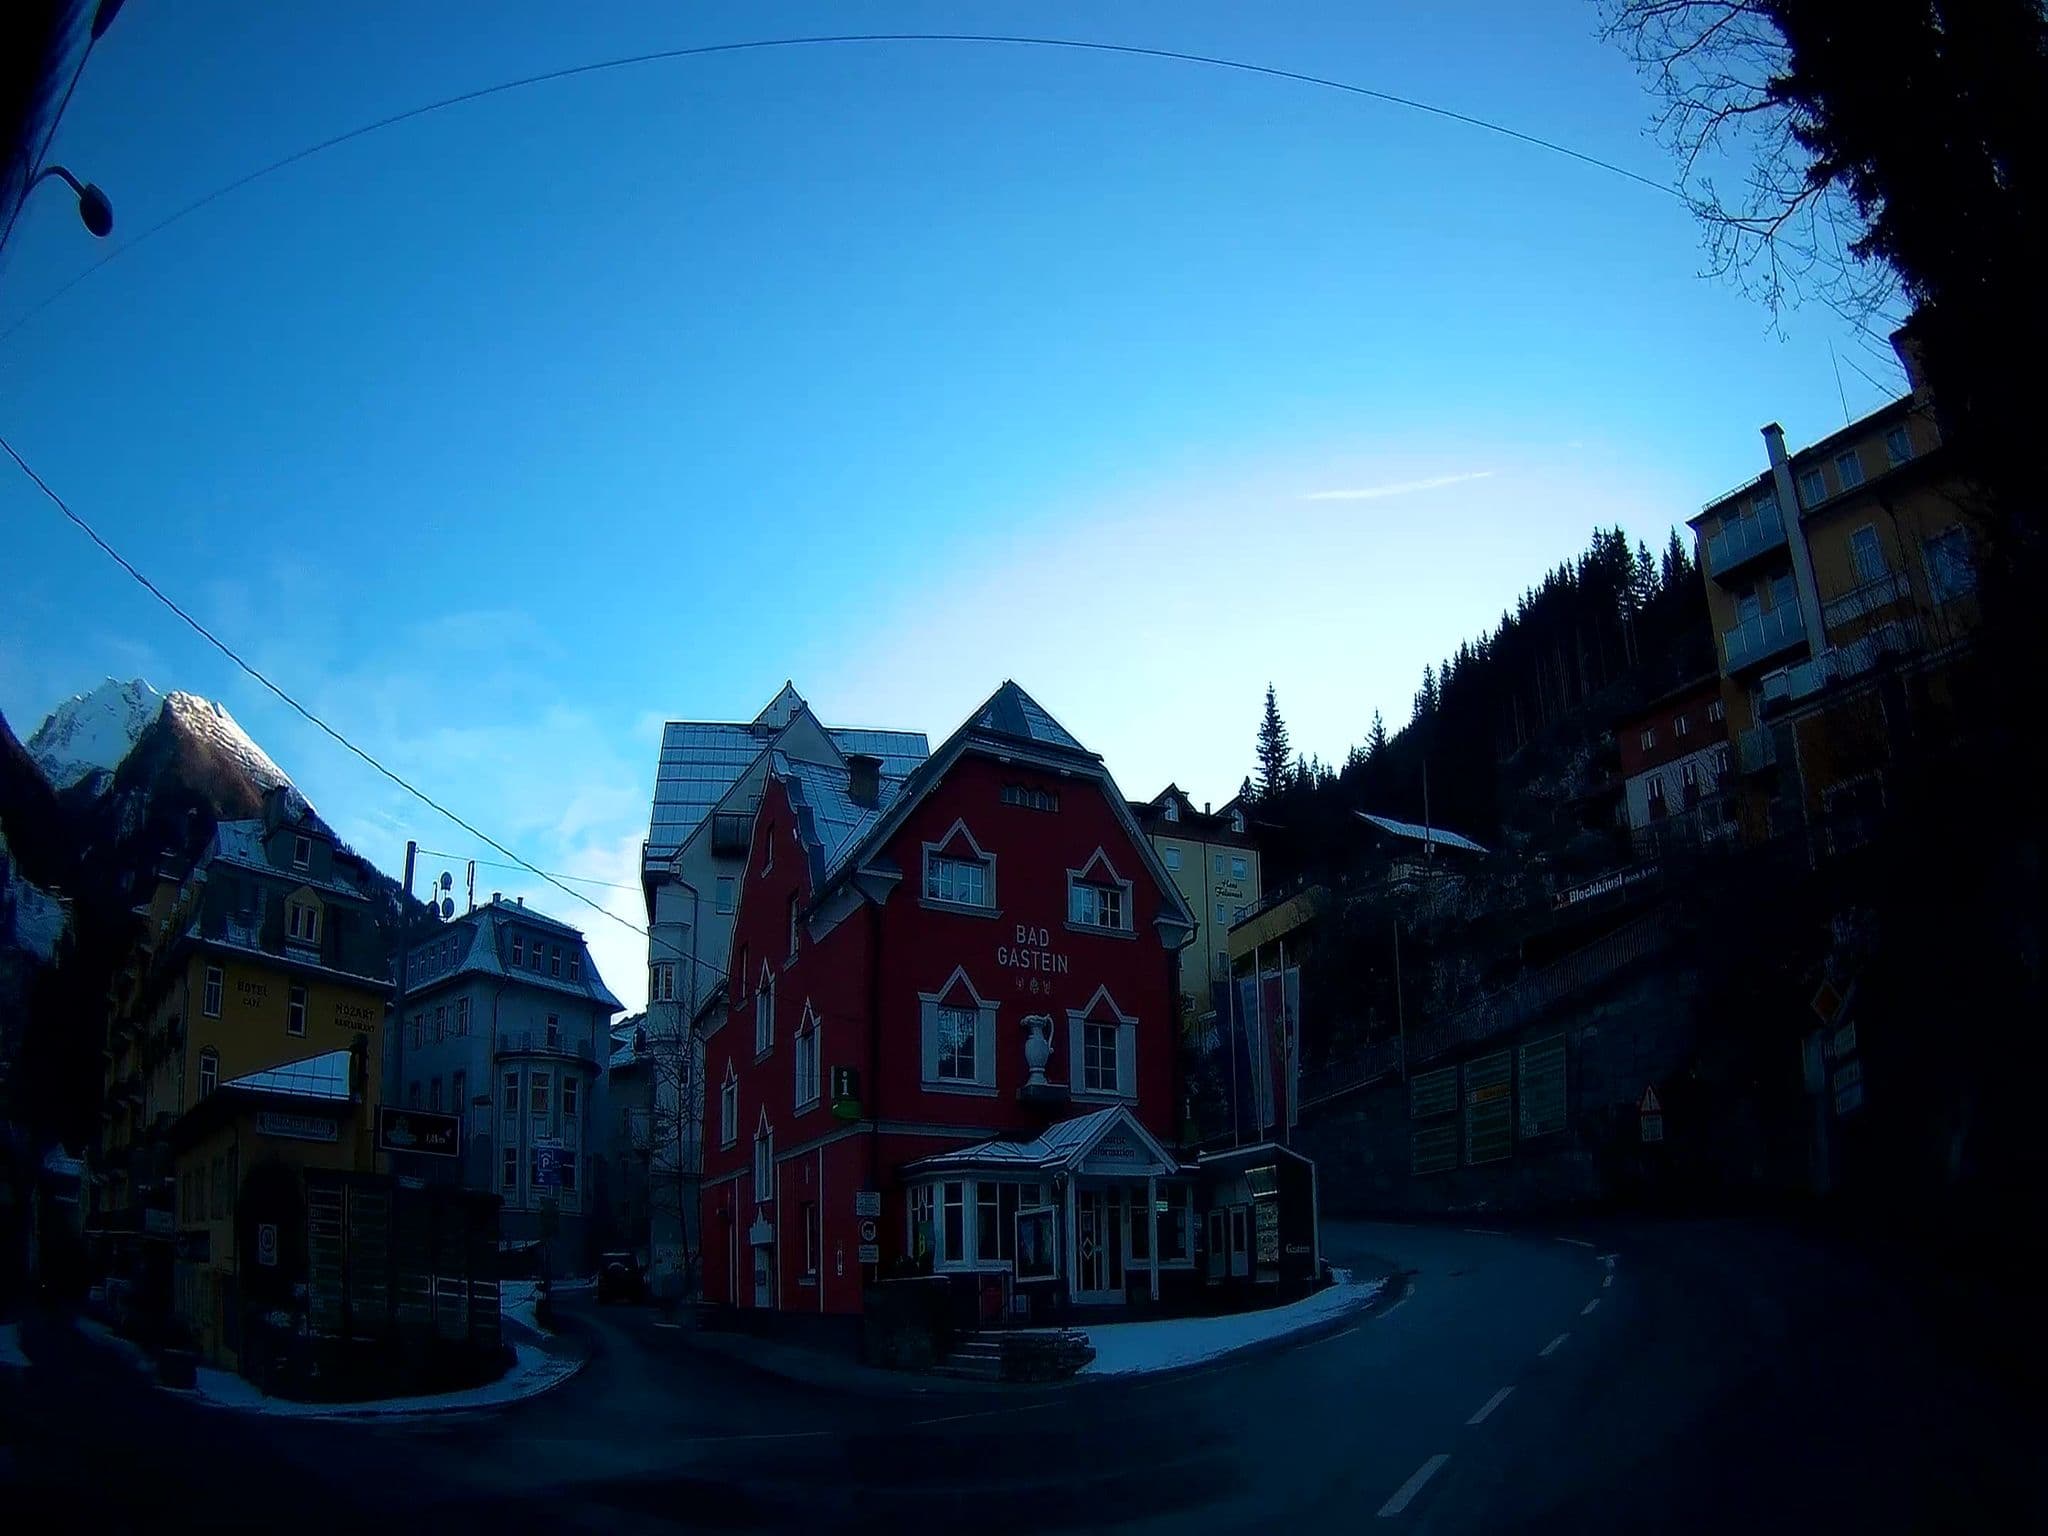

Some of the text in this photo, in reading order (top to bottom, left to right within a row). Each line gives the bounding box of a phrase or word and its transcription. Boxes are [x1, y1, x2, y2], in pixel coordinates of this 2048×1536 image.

[1016, 924, 1050, 948] BAD
[997, 946, 1069, 974] GASTEIN
[237, 980, 268, 997] HOTEL
[335, 1003, 375, 1021] MOZART
